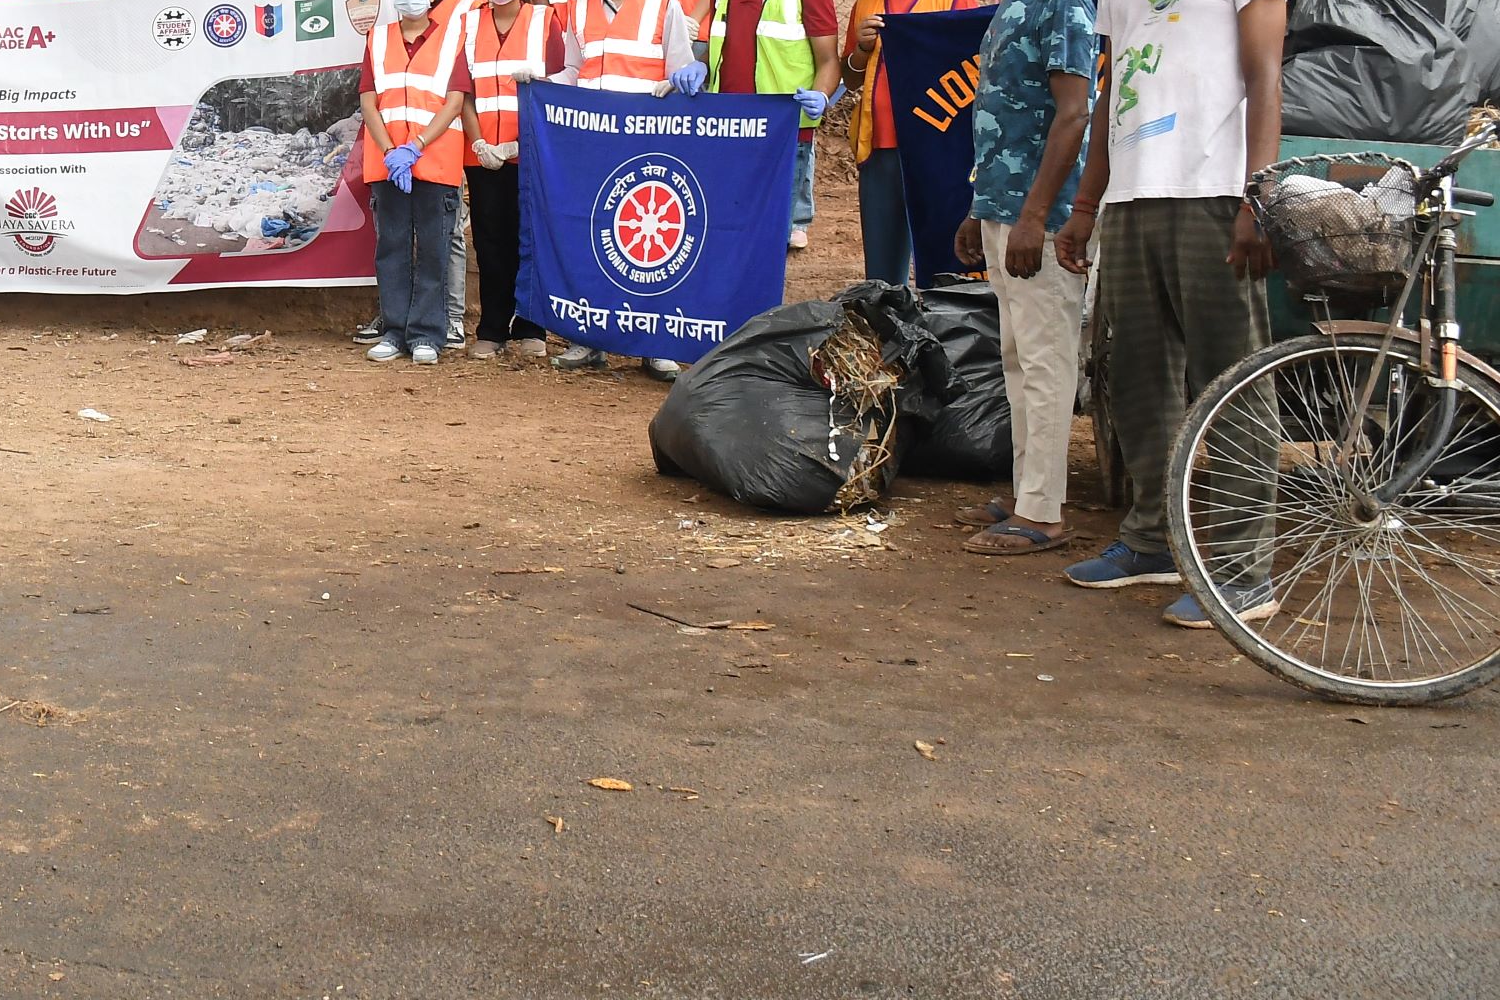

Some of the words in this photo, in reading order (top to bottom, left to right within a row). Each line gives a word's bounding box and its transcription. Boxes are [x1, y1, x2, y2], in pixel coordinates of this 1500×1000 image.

[26, 25, 56, 49] A+
[0, 89, 20, 103] Big
[24, 88, 77, 103] Impacts
[63, 120, 111, 140] With
[115, 120, 151, 138] Us”
[544, 103, 619, 134] NATIONAL
[624, 115, 692, 135] SERVICE
[696, 116, 768, 138] SCHEME
[60, 164, 86, 174] With
[604, 171, 636, 211] राष्ट्रीय
[641, 162, 668, 178] सेवा
[671, 171, 696, 216] योजना
[28, 219, 75, 230] SAVERA
[601, 229, 628, 276] NATIONAL
[629, 267, 668, 283] SERVICE
[668, 234, 695, 275] SCHEME
[18, 265, 79, 276] Plastic-Free
[82, 266, 117, 277] Future
[549, 295, 610, 334] राष्ट्रीय
[615, 302, 660, 334] सेवा
[664, 308, 727, 342] योजना
